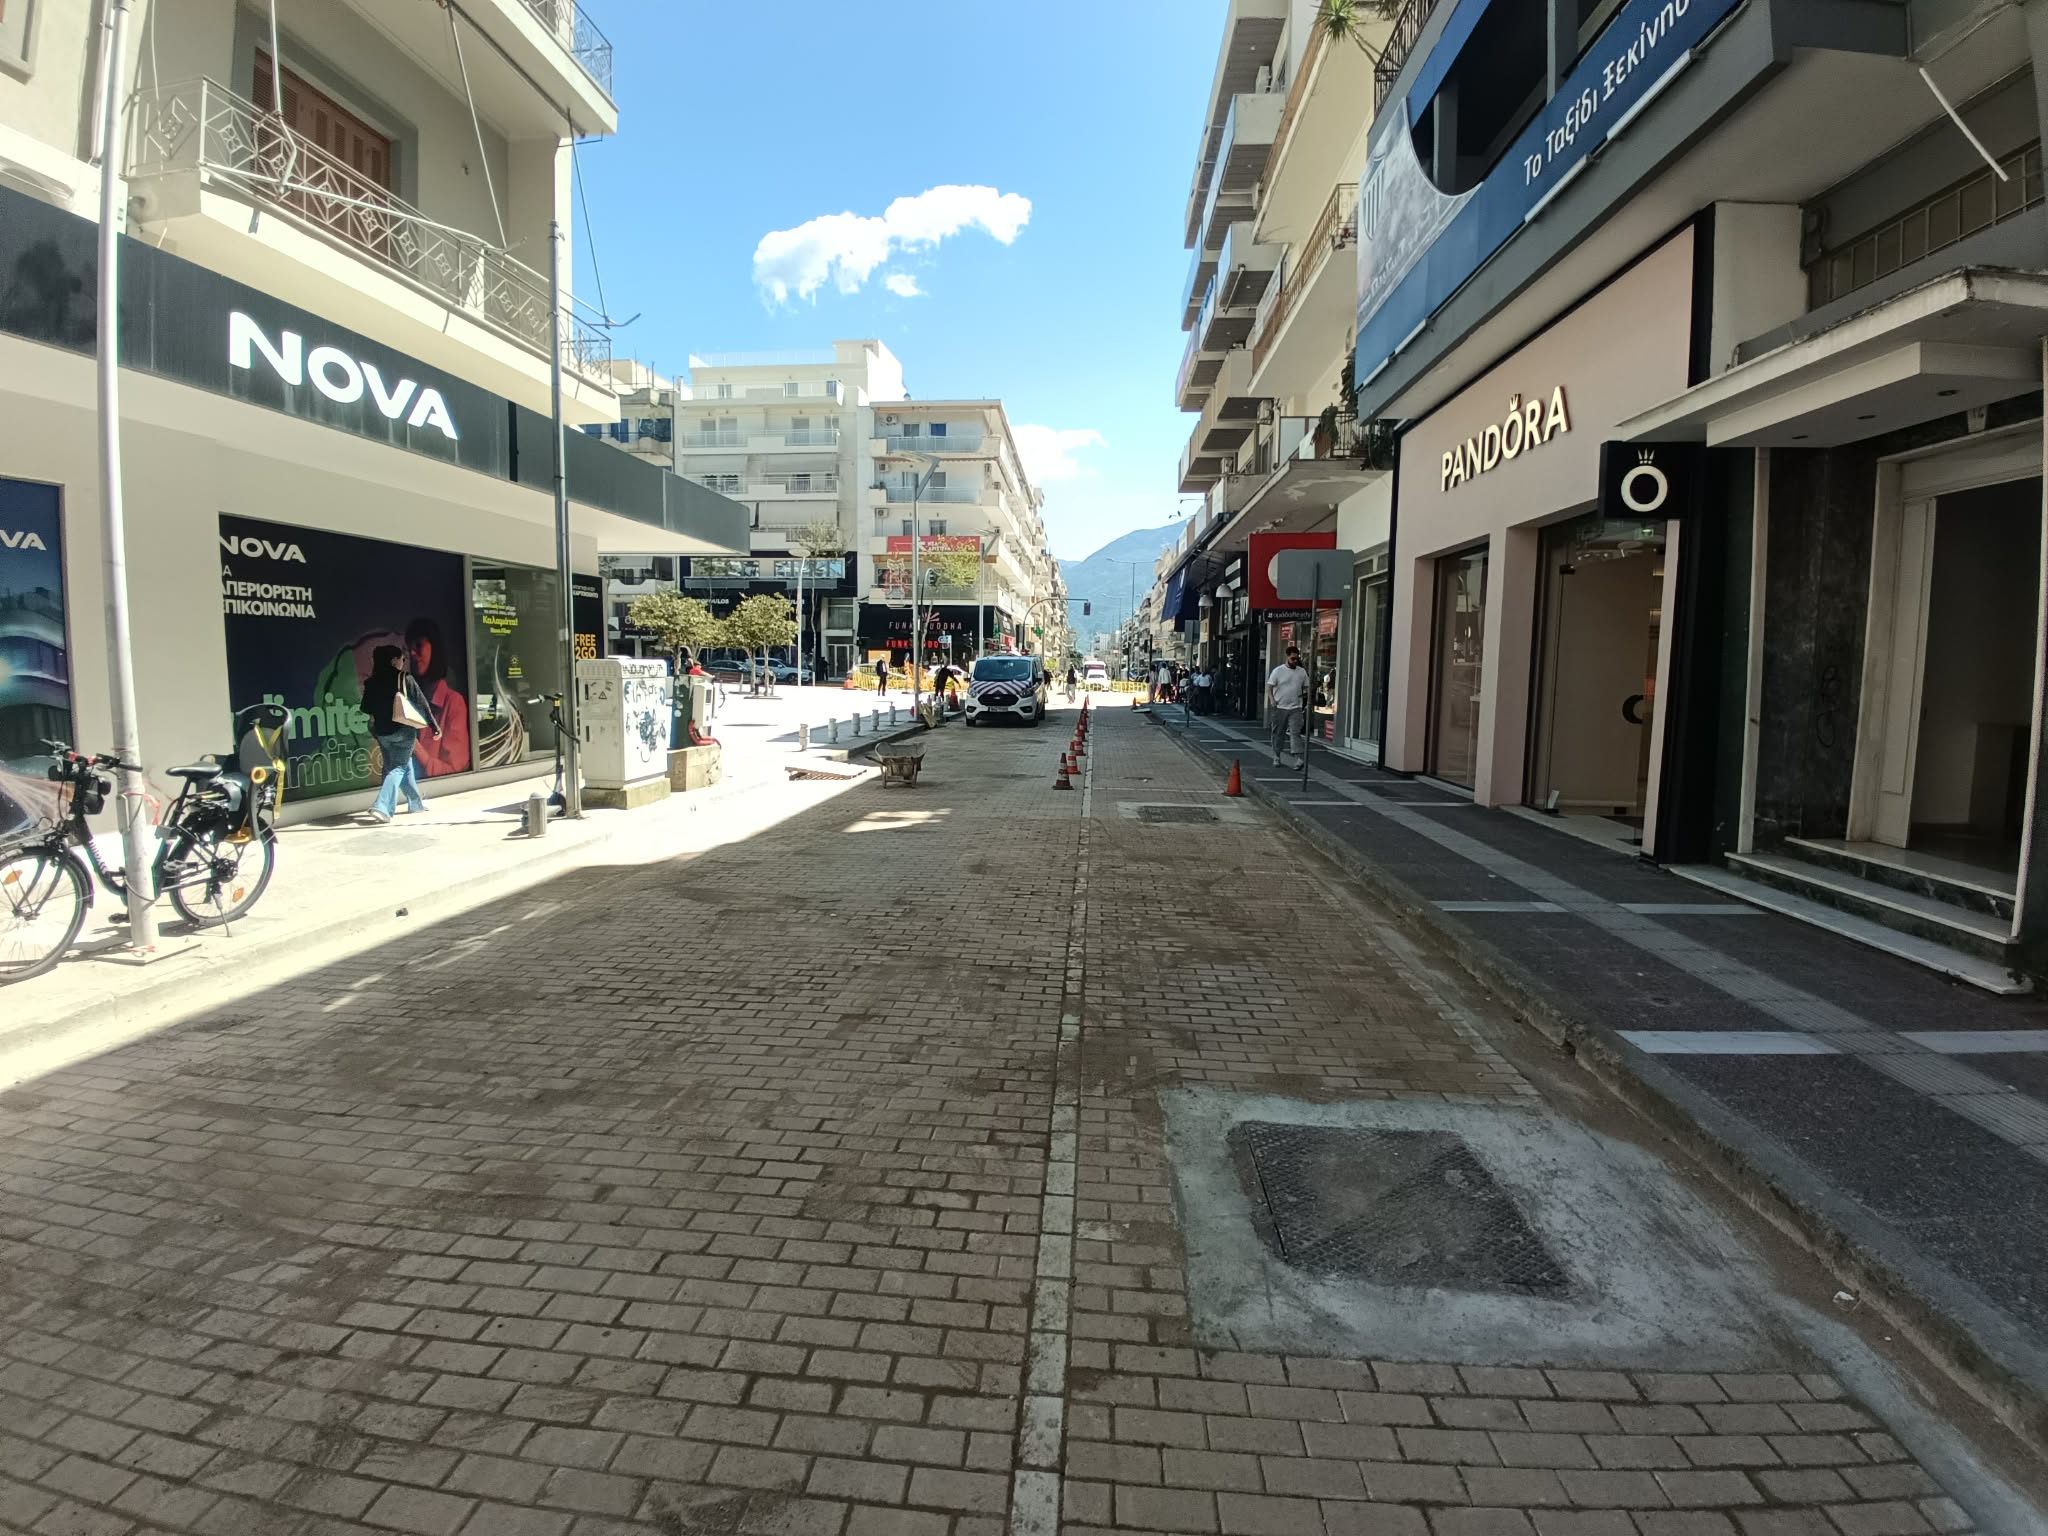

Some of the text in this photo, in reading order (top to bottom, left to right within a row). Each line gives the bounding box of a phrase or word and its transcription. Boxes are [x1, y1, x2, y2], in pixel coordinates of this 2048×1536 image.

[1524, 153, 1542, 185] Το
[1545, 87, 1598, 162] Ταξίδι
[229, 311, 459, 440] NOVA
[1440, 385, 1571, 492] PANDORA
[0, 529, 47, 551] VA
[223, 598, 317, 619] ΠΙΚΟΙΝΩΝΙΑ
[929, 621, 963, 631] UDDHA
[574, 633, 597, 647] FREE
[575, 646, 597, 660] 2GO
